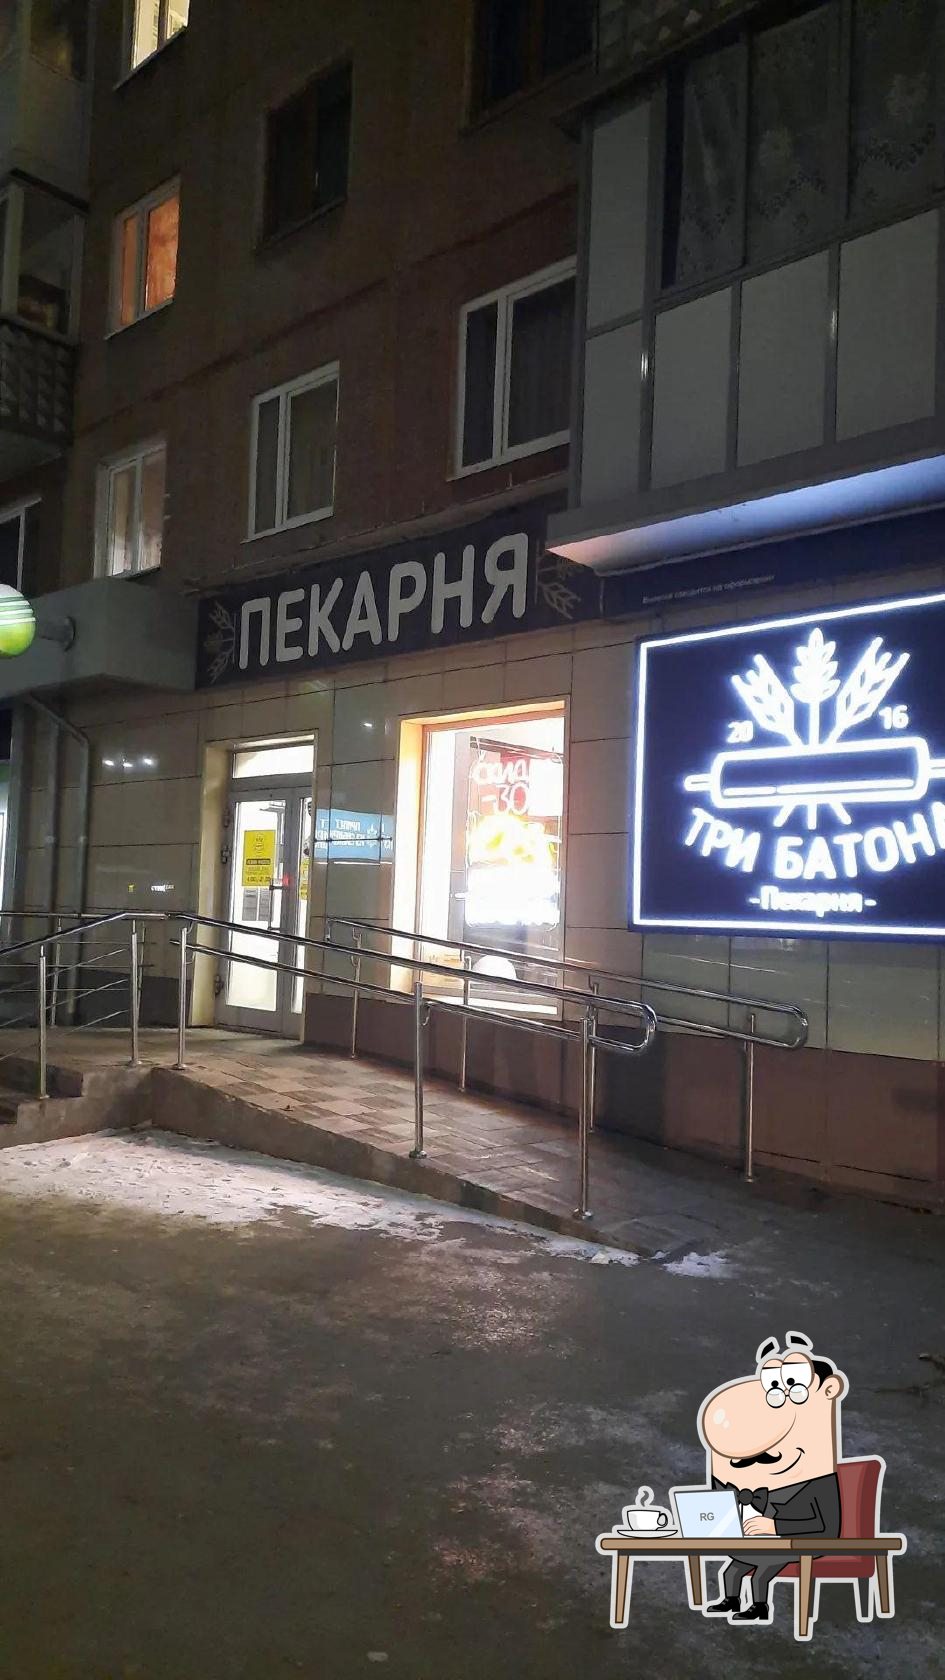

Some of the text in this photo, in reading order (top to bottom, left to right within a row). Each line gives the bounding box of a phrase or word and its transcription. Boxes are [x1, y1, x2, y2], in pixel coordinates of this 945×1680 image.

[239, 533, 528, 669] ПЕКАРНЯ
[727, 705, 909, 743] 20 16
[685, 808, 760, 872] ТРИ
